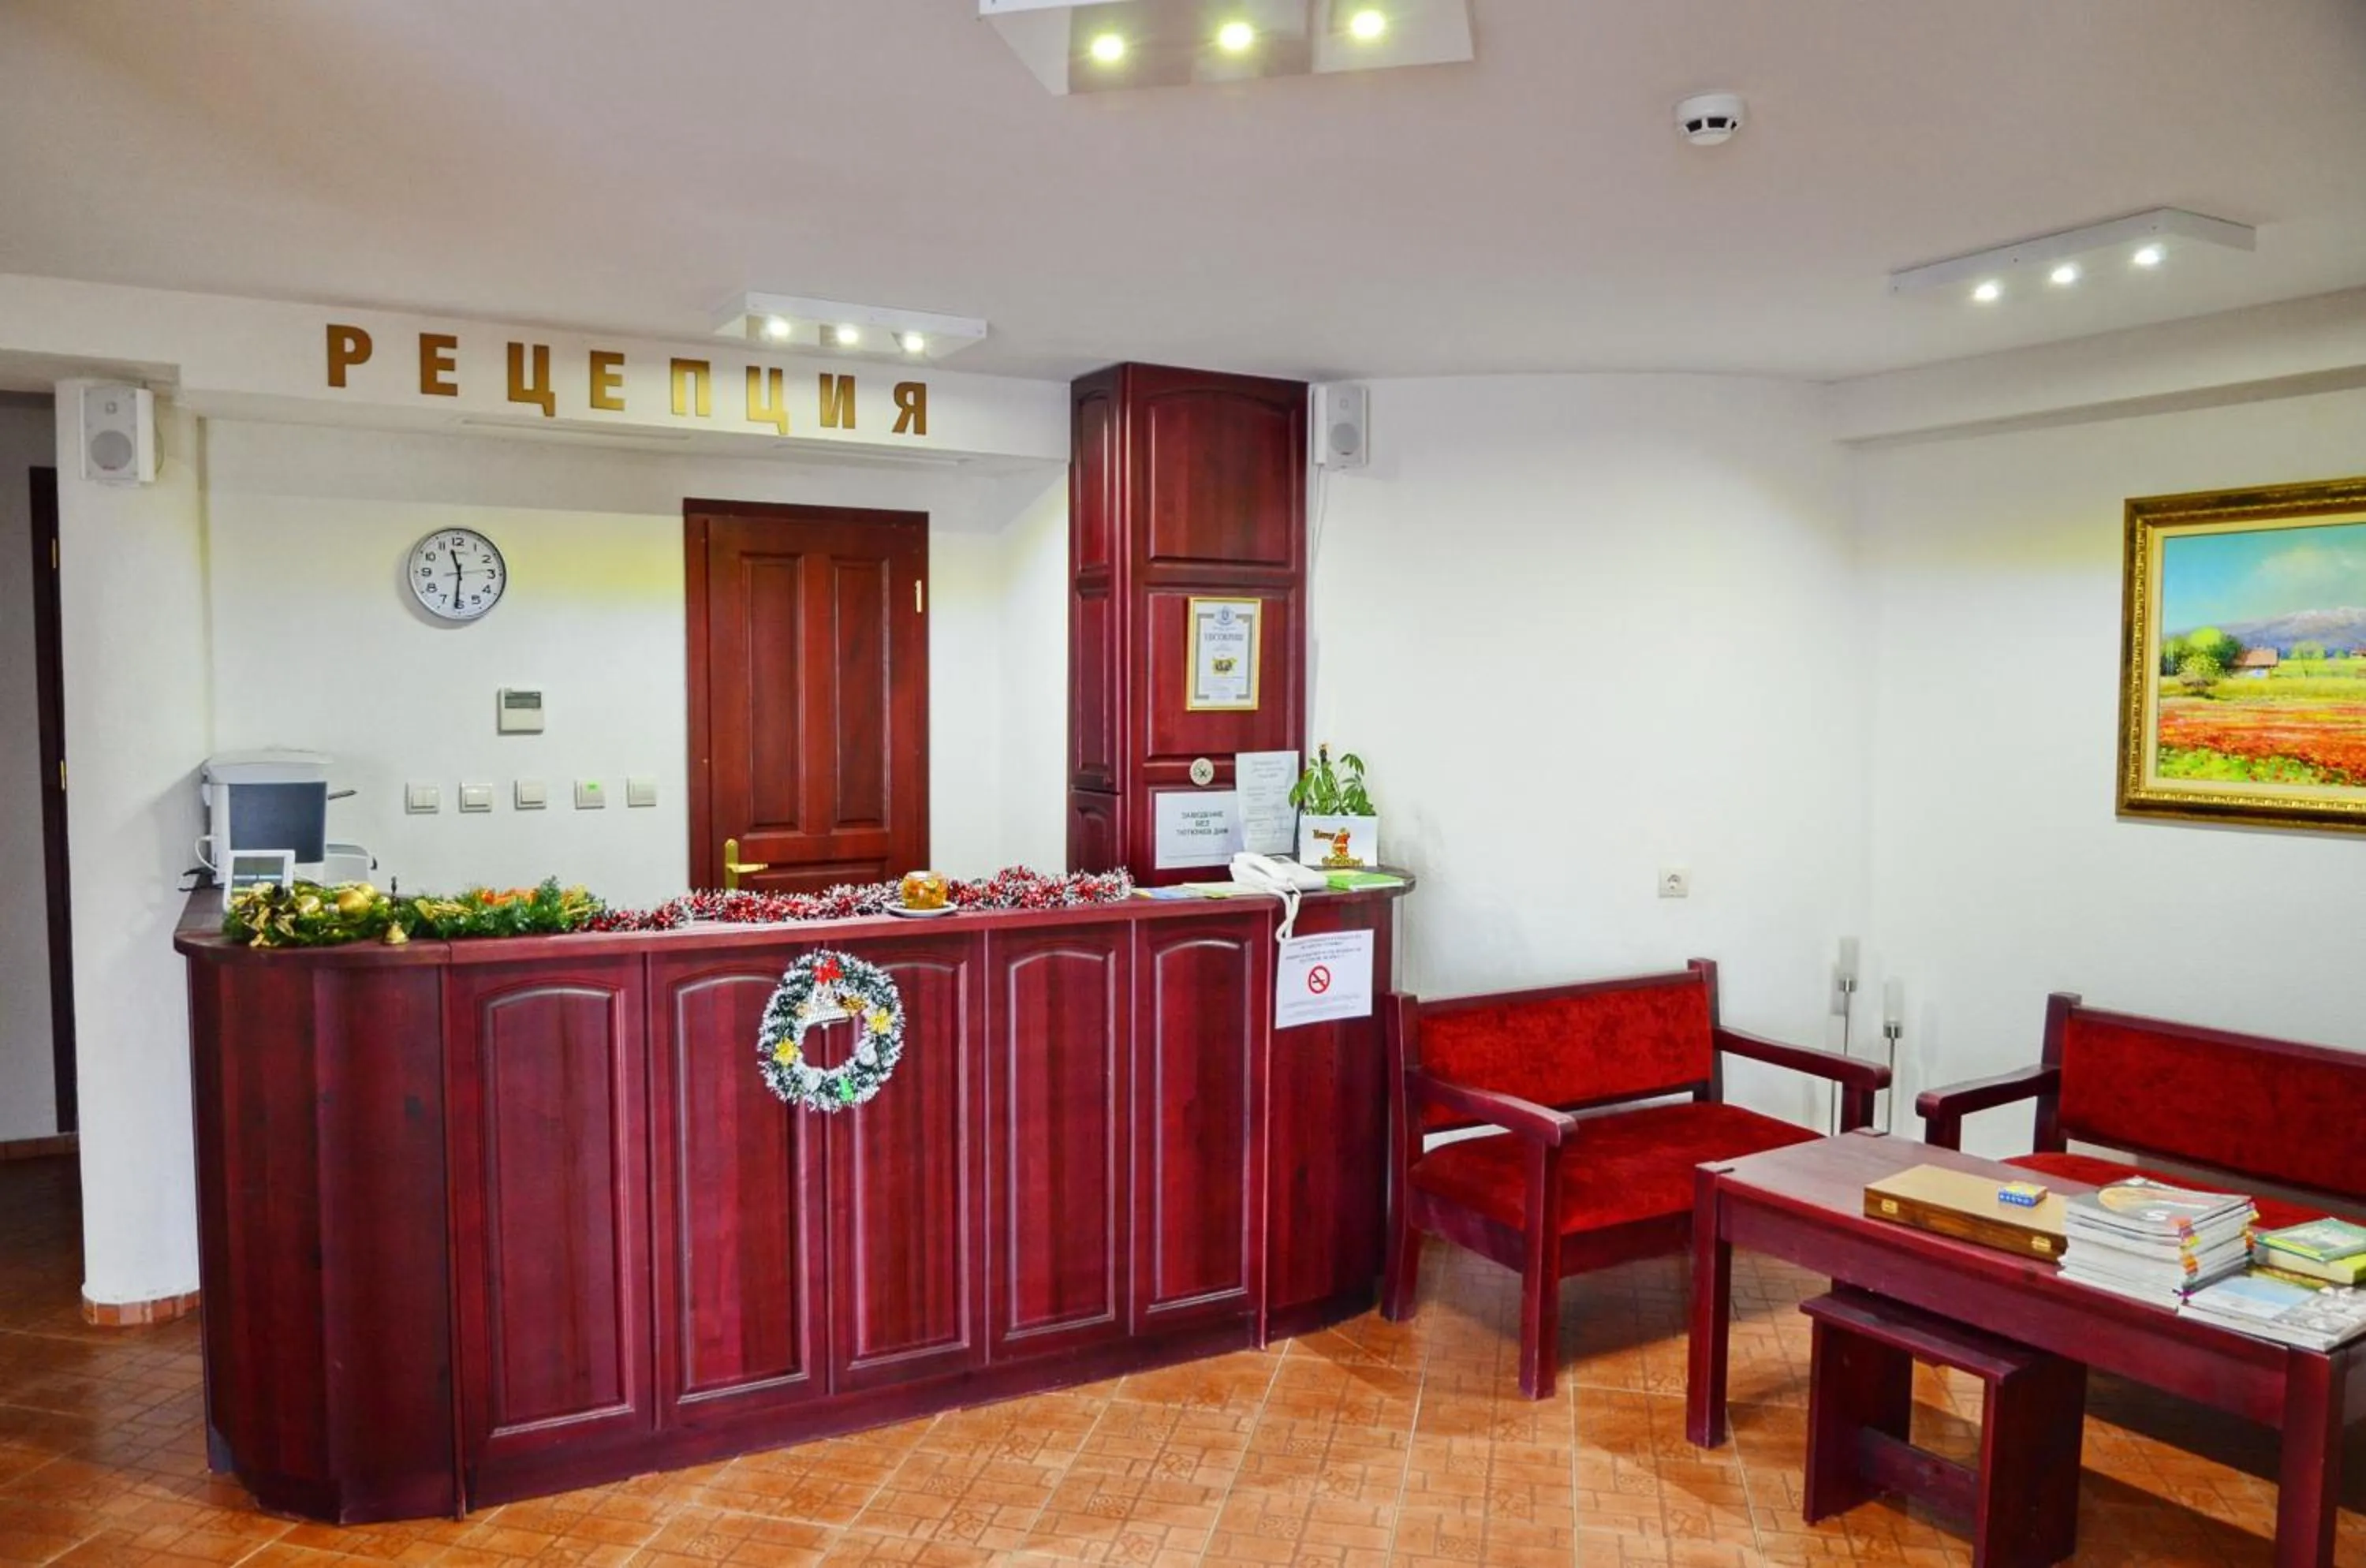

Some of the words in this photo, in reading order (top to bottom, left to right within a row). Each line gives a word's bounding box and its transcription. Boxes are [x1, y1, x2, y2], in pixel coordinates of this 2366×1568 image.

[327, 323, 927, 435] РЕЦЕПЦИЯ
[452, 537, 464, 546] 12
[426, 552, 436, 562] 10
[482, 554, 491, 563] 2
[422, 568, 431, 577] 9
[487, 569, 496, 579] 3
[427, 583, 438, 593] 8
[483, 584, 491, 593] 4
[440, 594, 447, 603] 7
[471, 595, 481, 605] 5
